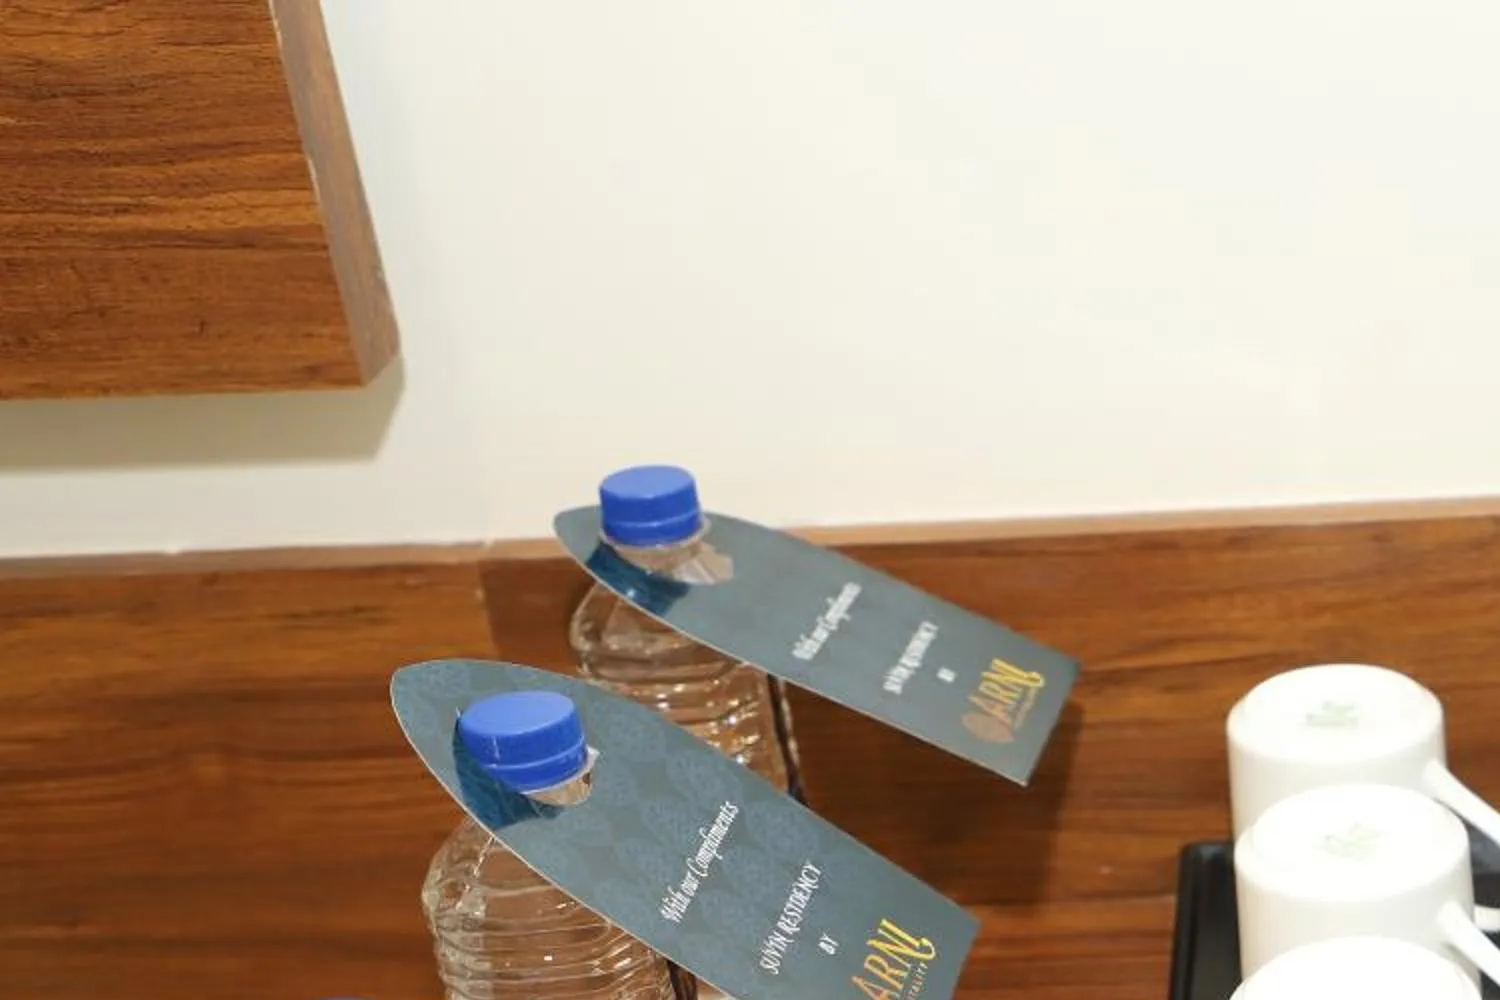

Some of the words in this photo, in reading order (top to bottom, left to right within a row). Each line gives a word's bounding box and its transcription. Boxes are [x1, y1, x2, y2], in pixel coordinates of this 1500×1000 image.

[660, 886, 691, 923] With
[686, 800, 739, 877] Compliments
[777, 862, 821, 934] RESIDENCY
